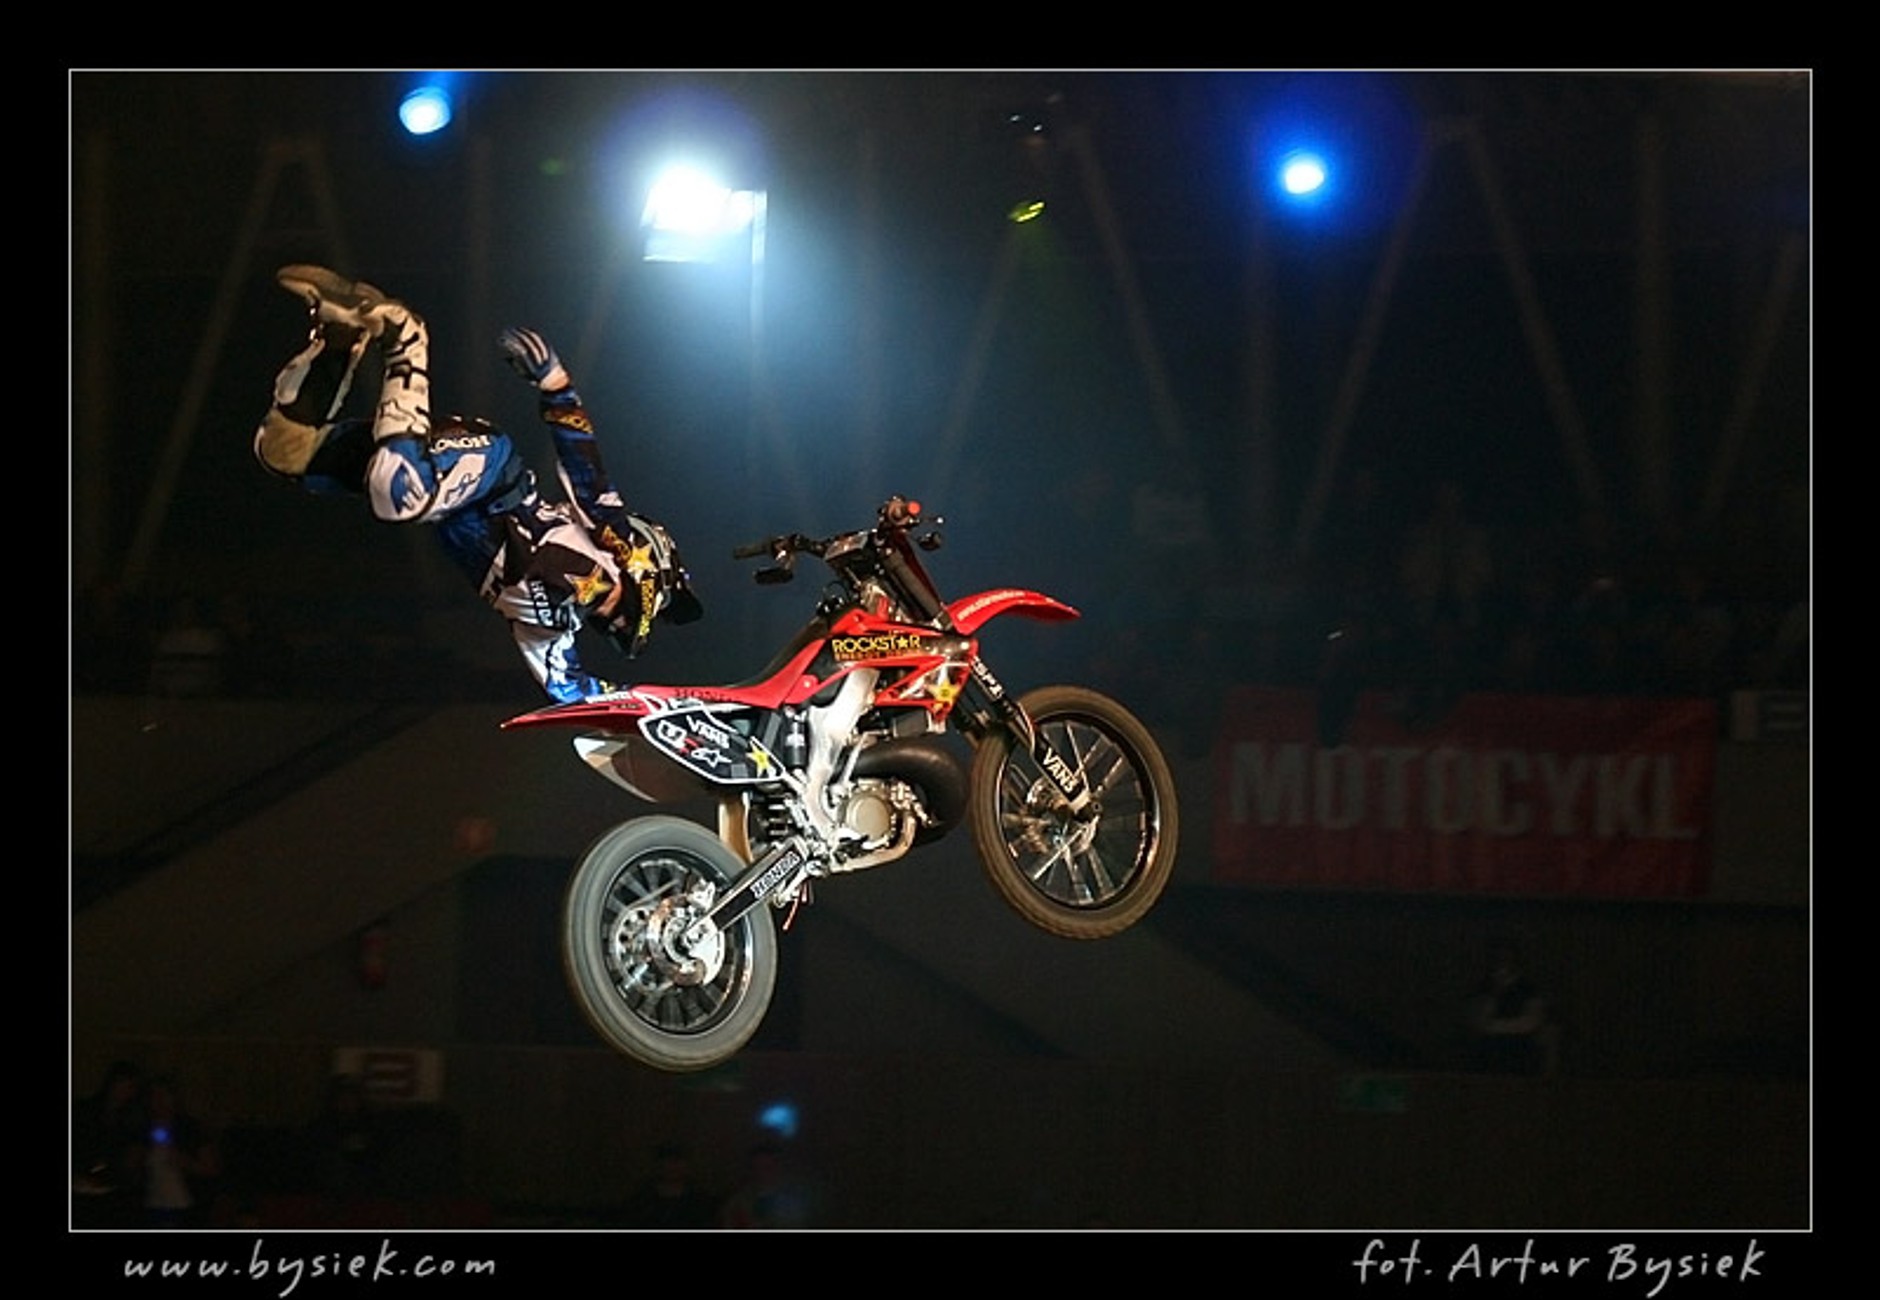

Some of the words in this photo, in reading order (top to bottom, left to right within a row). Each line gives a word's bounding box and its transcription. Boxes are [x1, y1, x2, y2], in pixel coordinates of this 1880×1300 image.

[1043, 747, 1081, 793] VANS
[1229, 739, 1701, 842] MOTOCYKL
[751, 851, 801, 899] HONDA
